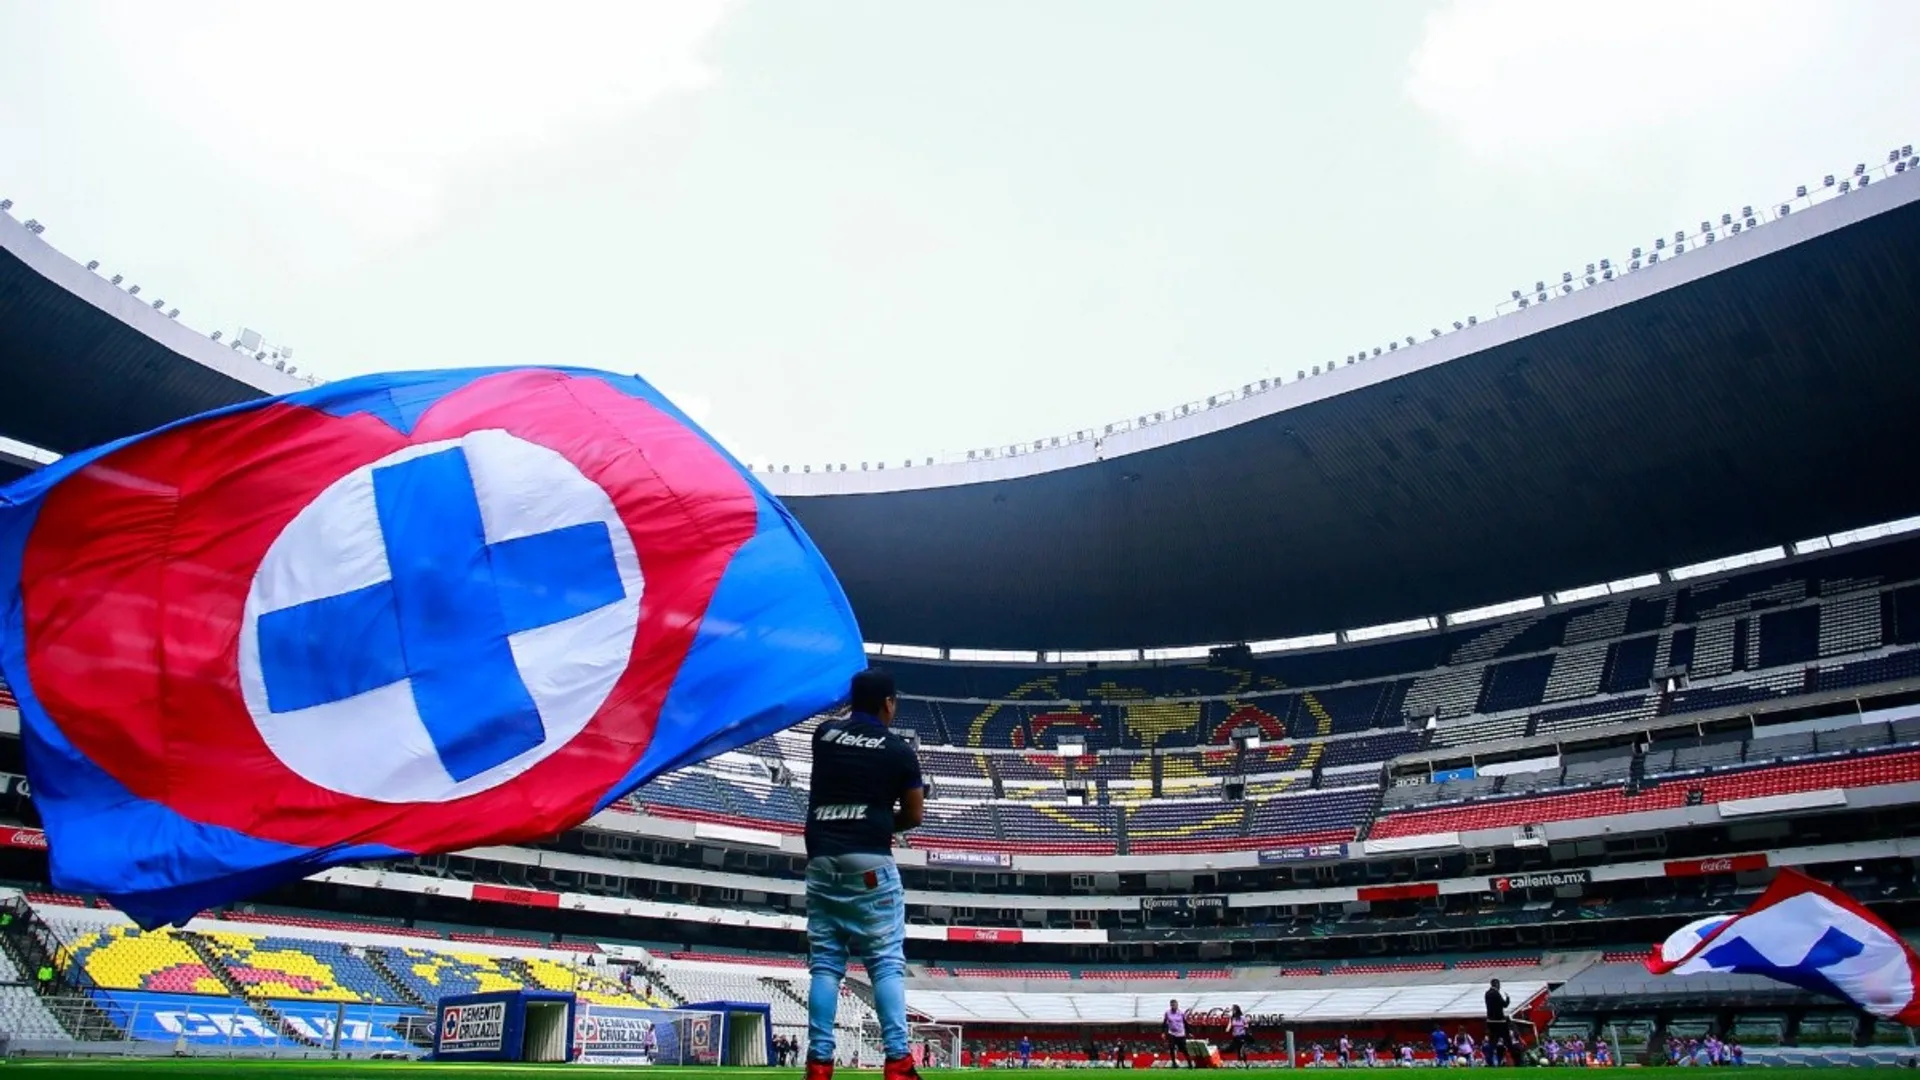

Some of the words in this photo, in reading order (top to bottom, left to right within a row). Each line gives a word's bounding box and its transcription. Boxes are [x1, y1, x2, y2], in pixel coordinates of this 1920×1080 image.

[836, 732, 885, 748] telcel
[814, 805, 867, 820] TECATE
[1509, 873, 1585, 888] caliente.mx
[461, 1005, 501, 1022] CEMENTO
[1244, 1013, 1285, 1027] OUNGE
[597, 1018, 650, 1031] CEMENTO
[600, 1028, 627, 1042] CRUZ
